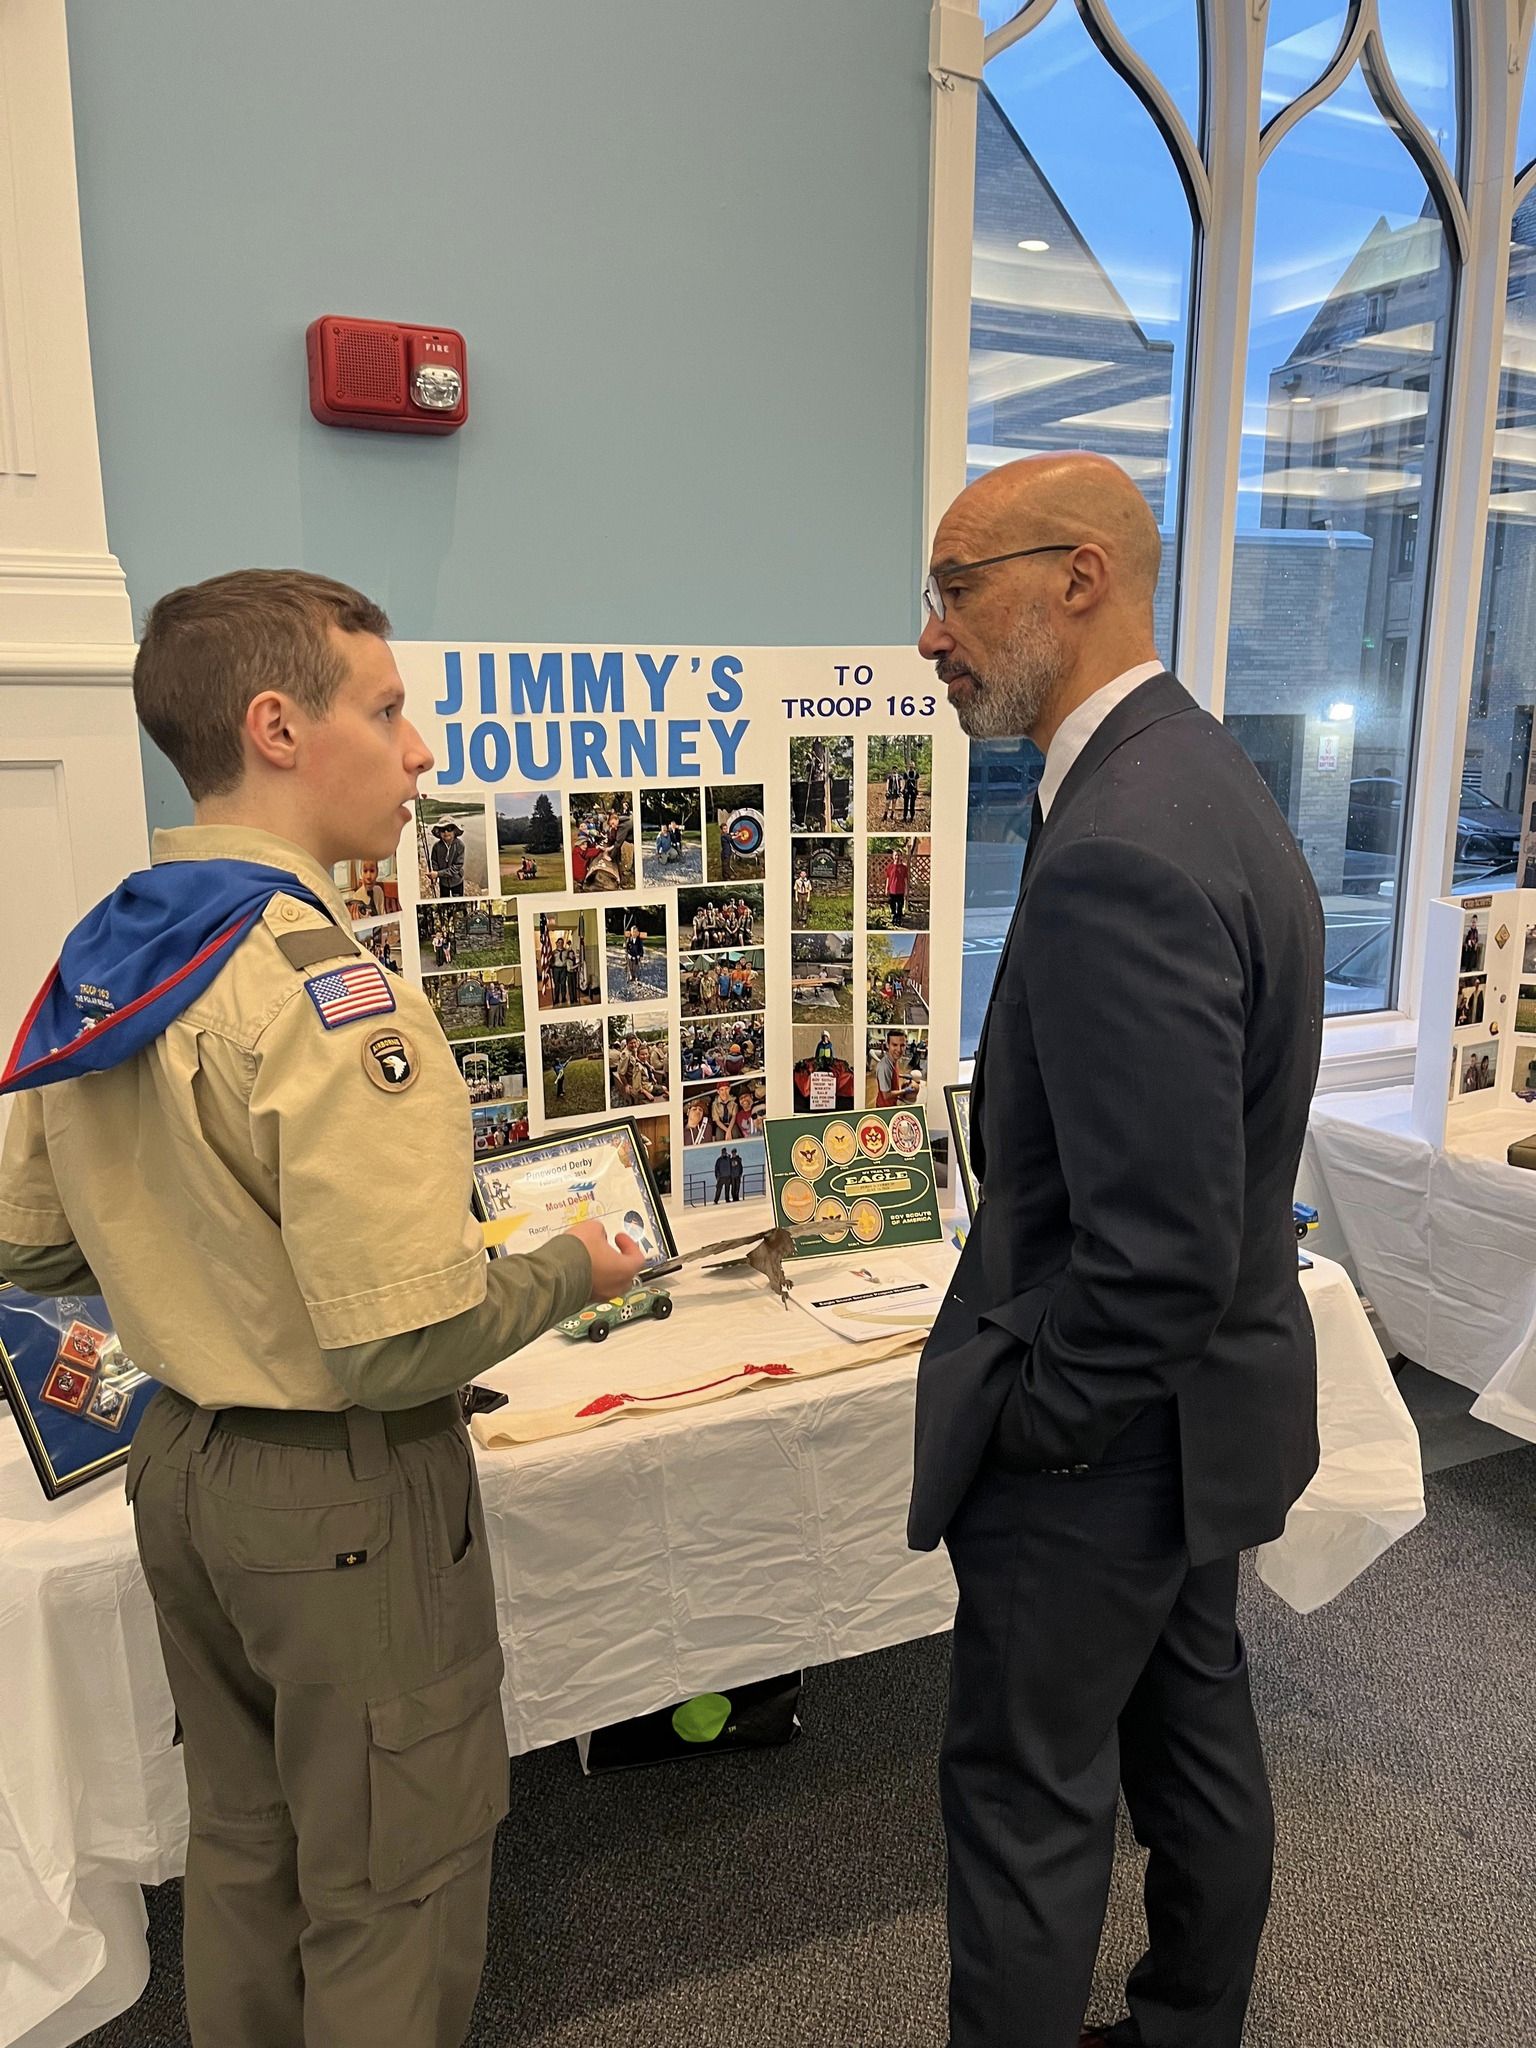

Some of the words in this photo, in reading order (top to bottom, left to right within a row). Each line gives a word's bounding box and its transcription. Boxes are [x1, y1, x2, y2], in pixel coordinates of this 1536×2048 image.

[425, 343, 449, 353] FIRE
[435, 651, 744, 715] JIMMY'S
[834, 665, 873, 686] TO
[781, 697, 872, 719] TROOP
[887, 696, 936, 716] 163
[437, 719, 750, 785] JOURNEY
[79, 984, 97, 995] TROOP
[97, 988, 110, 1000] 163
[372, 1039, 400, 1053] AIRBORNE
[526, 1164, 567, 1181] Pinewood
[569, 1158, 593, 1170] Derby
[845, 1171, 908, 1185] EAGLE
[545, 1201, 566, 1212] Most
[902, 1216, 932, 1224] AMERICA
